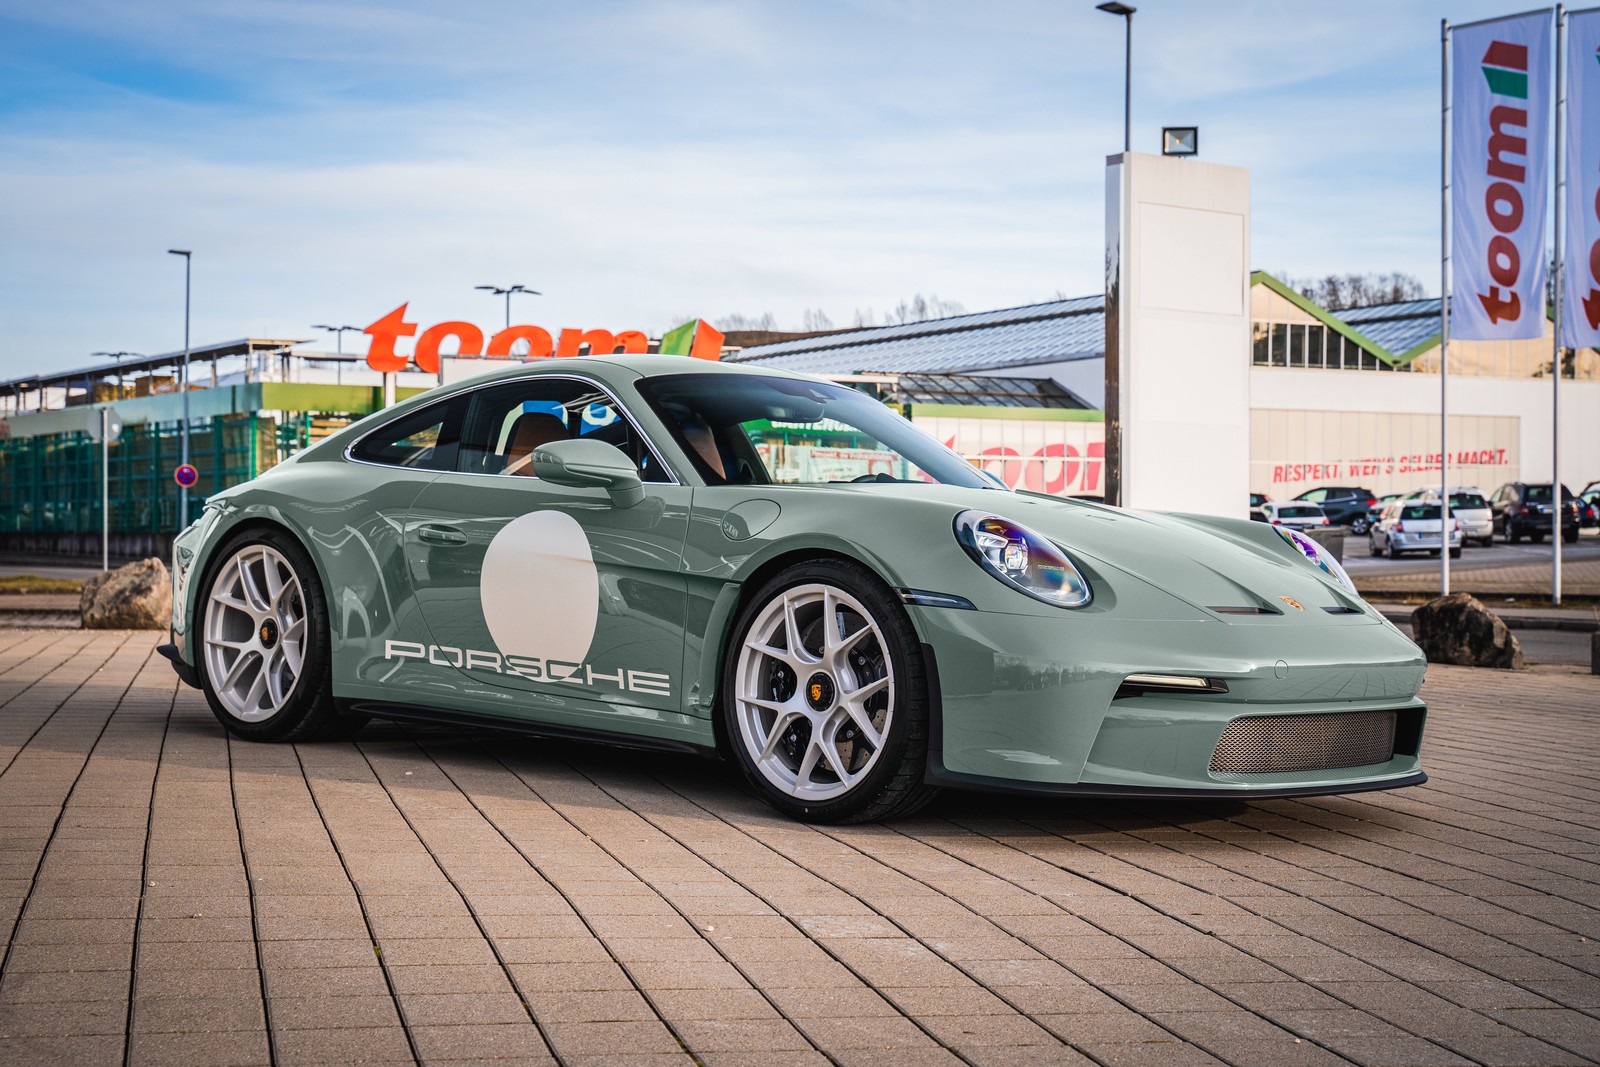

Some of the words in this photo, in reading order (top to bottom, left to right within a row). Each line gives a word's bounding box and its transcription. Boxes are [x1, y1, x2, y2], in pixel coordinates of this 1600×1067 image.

[1477, 105, 1528, 325] toom
[364, 302, 648, 374] toom
[385, 640, 671, 696] PORSCHE
